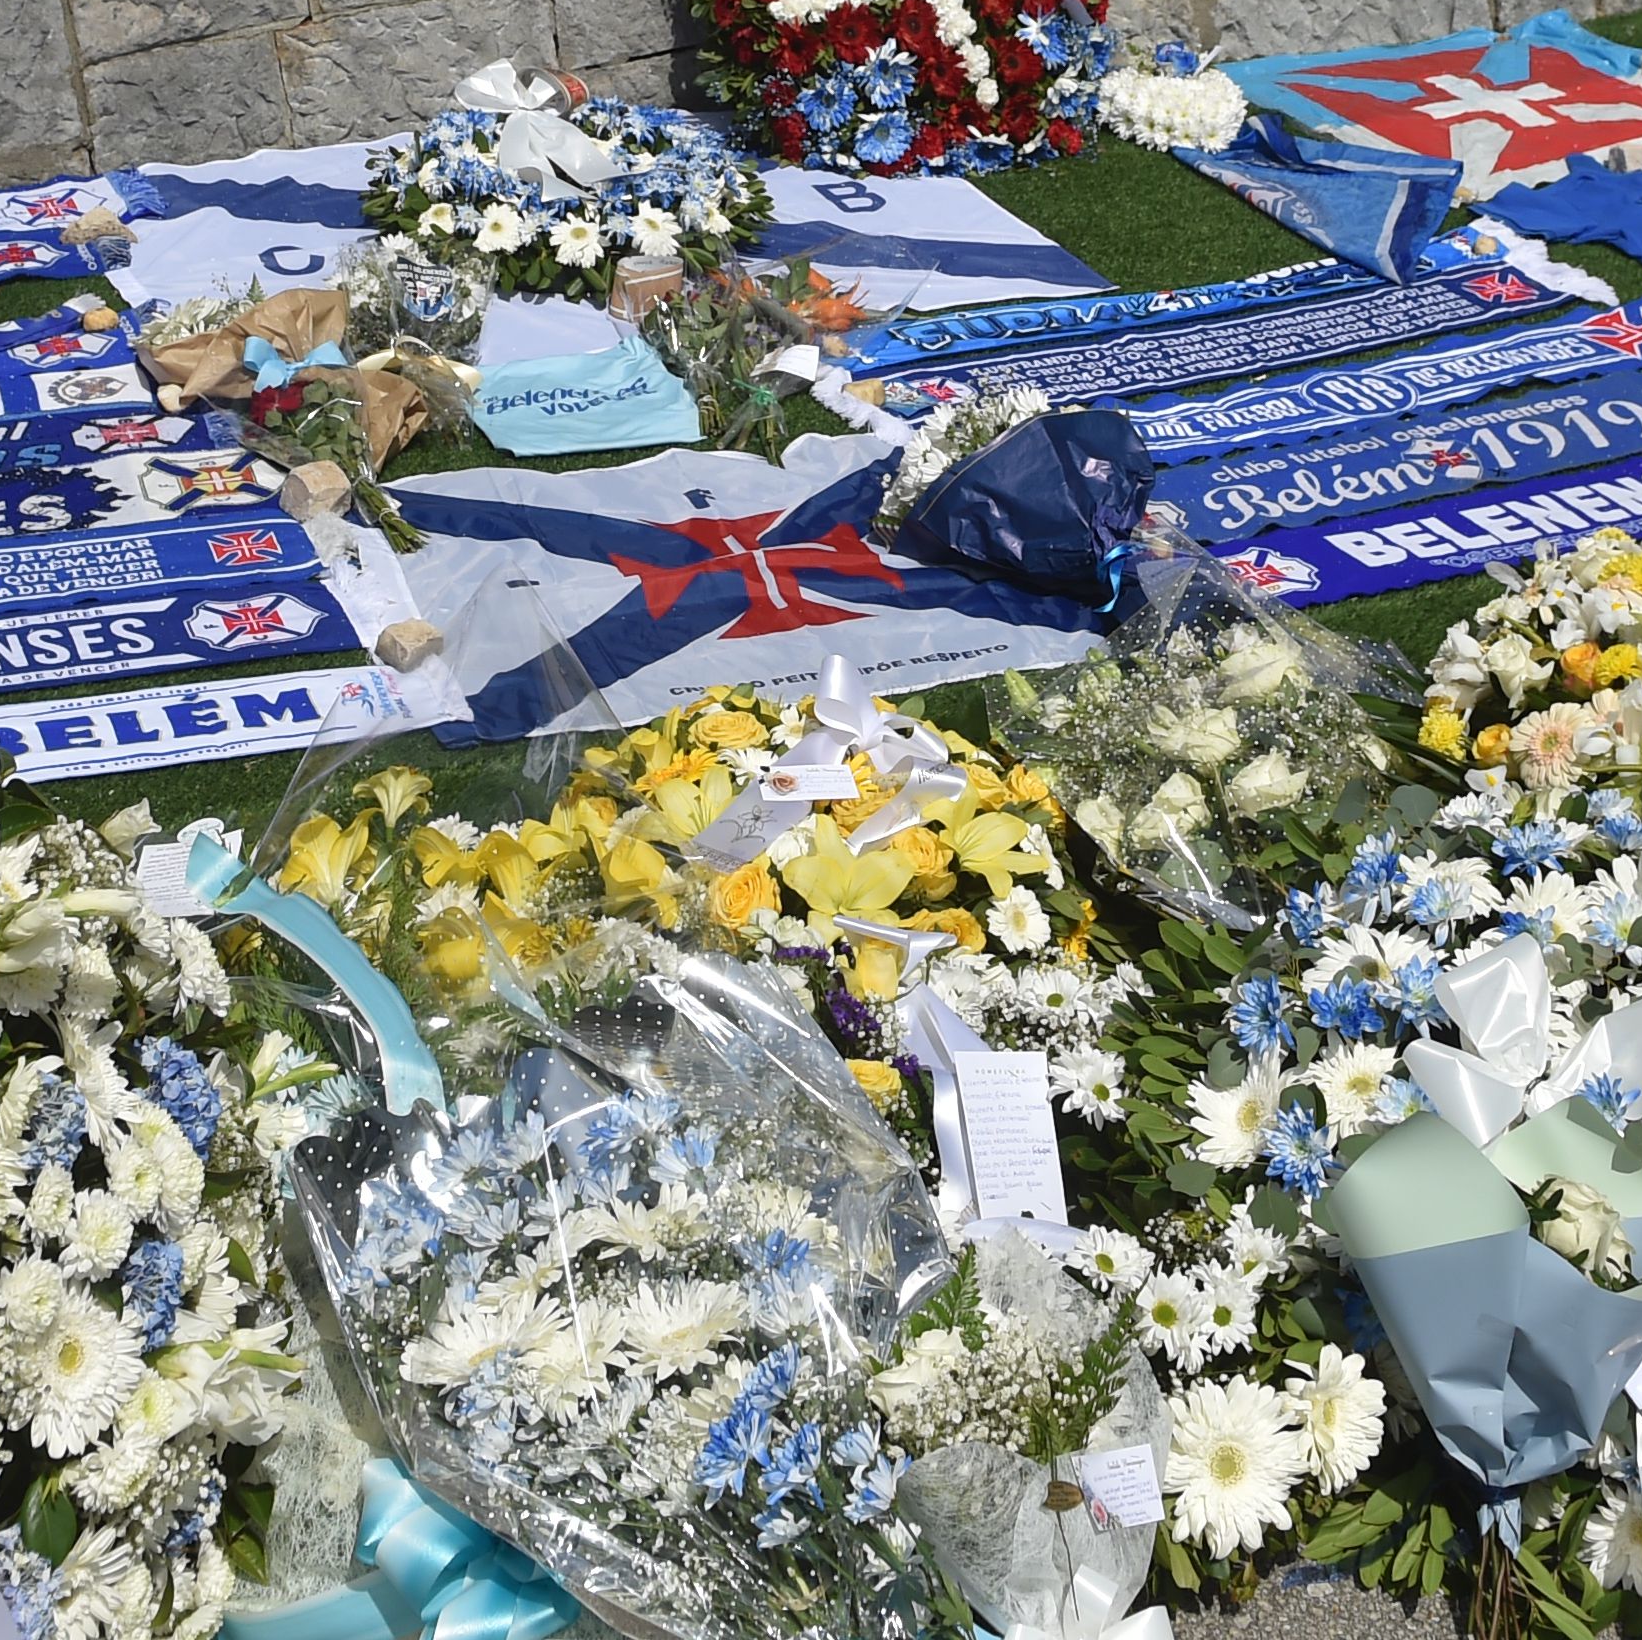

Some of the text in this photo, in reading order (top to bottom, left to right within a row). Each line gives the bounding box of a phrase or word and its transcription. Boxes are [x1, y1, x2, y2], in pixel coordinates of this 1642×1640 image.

[1250, 304, 1362, 331] CONSAGRADO
[1375, 284, 1447, 306] POPULAR
[1026, 365, 1075, 378] CRUZ
[1255, 312, 1355, 340] CONQUISTAS
[1046, 300, 1472, 384] COMO NADA TEMOS QUE TEMER
[1259, 346, 1299, 361] COM
[1318, 328, 1392, 349] CERTEZA
[1393, 323, 1413, 335] DE
[1211, 456, 1285, 483] clube
[1289, 435, 1385, 467] futebol
[1204, 462, 1435, 530] Belém
[36, 538, 152, 560] POPULAR
[4, 570, 58, 586] QUE
[68, 560, 160, 579] TEMER
[18, 582, 52, 597] DE
[57, 569, 165, 591] VENCER!
[43, 609, 105, 622] TEMER
[909, 644, 1009, 666] RESPEITO
[22, 672, 42, 682] DE
[53, 662, 131, 677] VENCER
